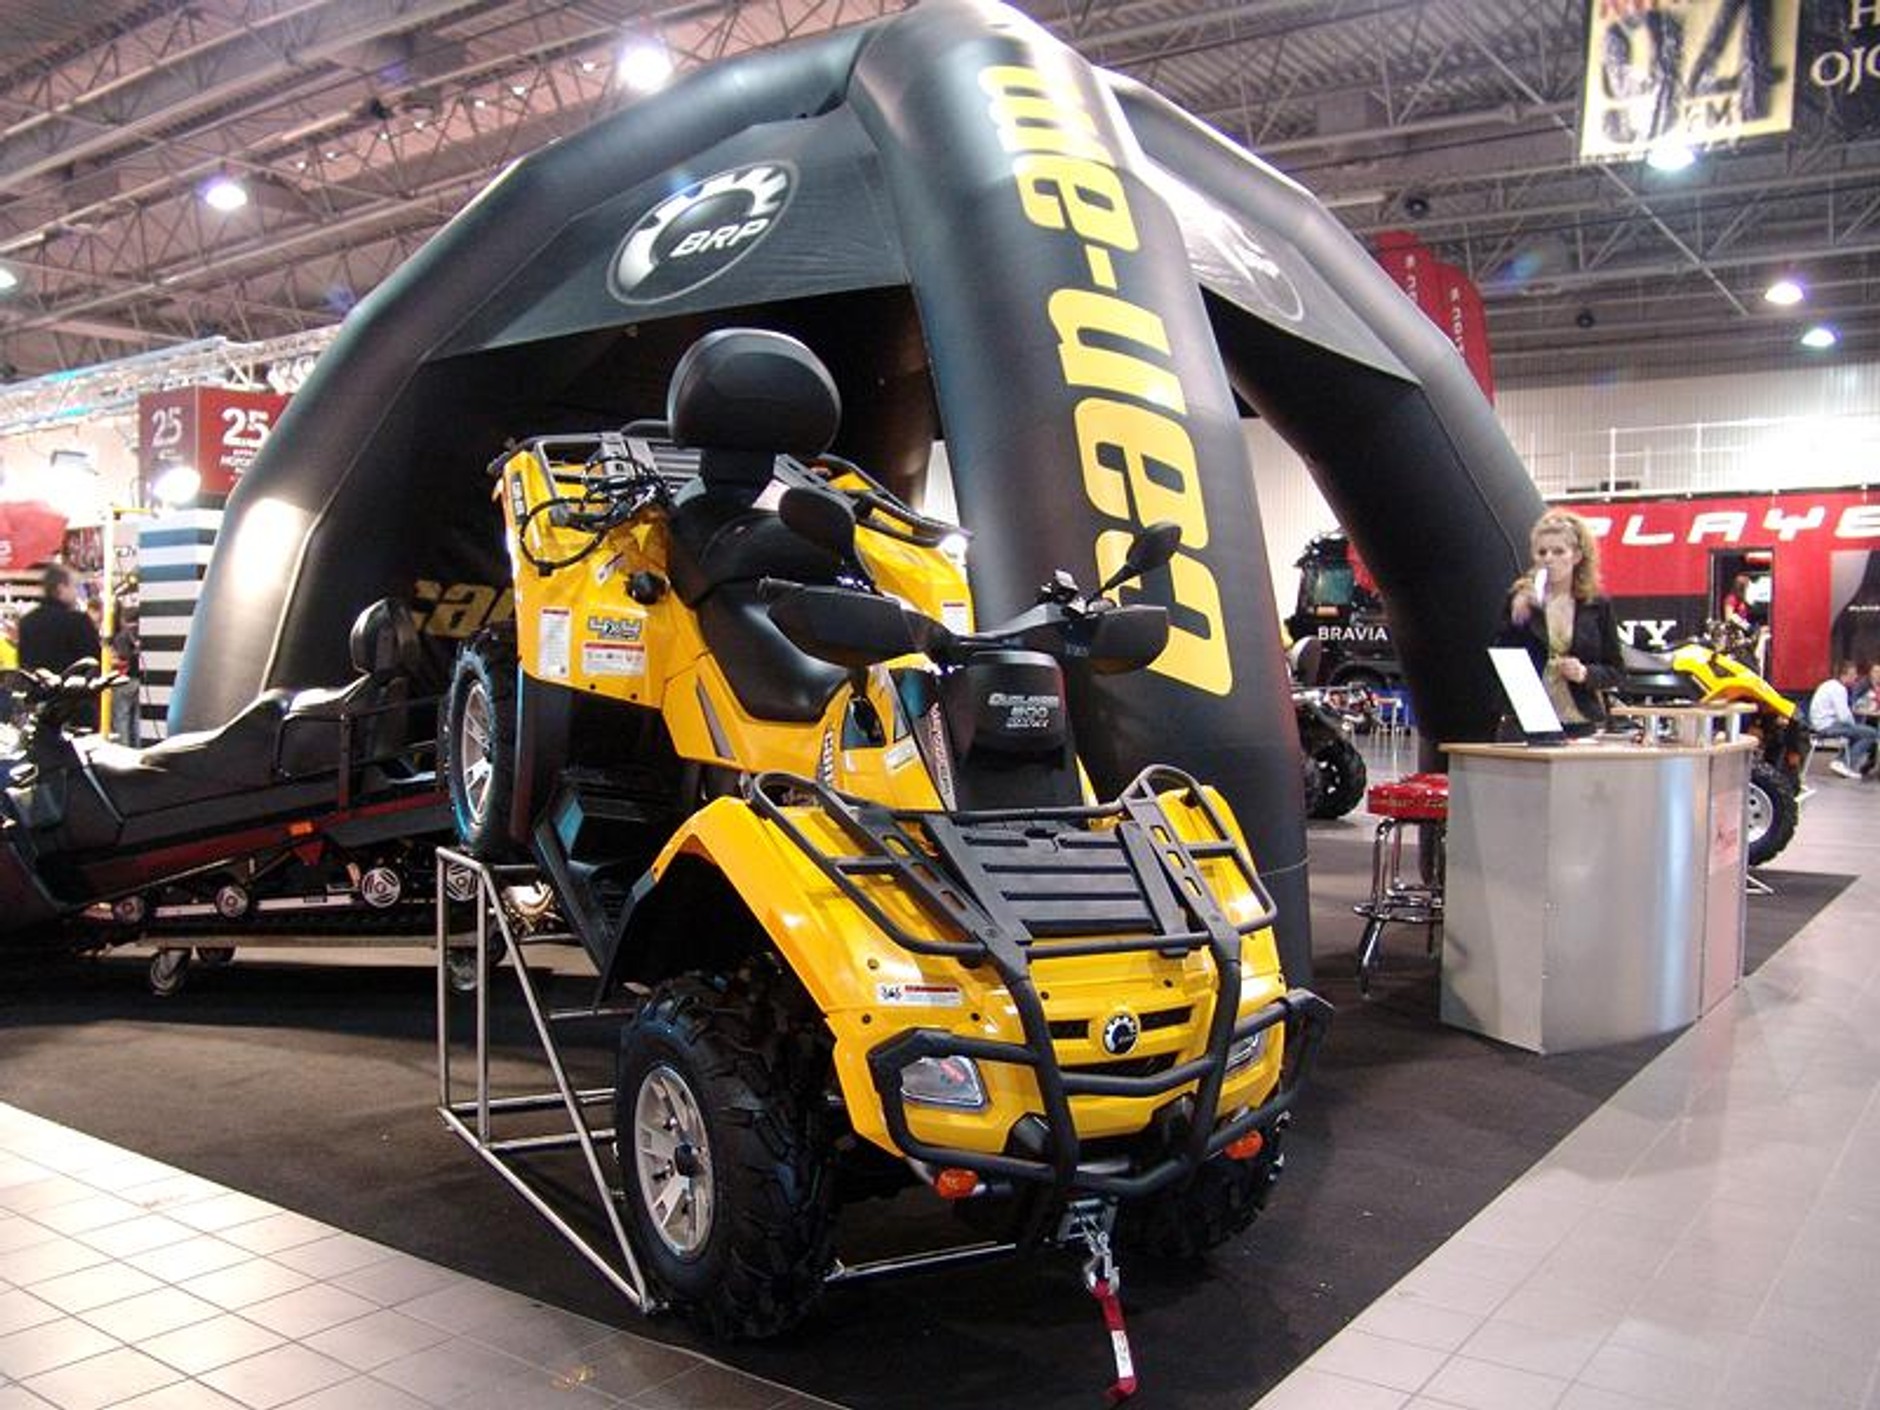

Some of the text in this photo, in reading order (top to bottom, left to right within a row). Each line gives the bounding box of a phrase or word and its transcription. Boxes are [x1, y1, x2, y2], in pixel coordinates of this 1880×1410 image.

[669, 218, 770, 258] BRP
[151, 406, 183, 447] 25
[221, 406, 271, 448] 25
[1317, 626, 1388, 641] BRAVIA
